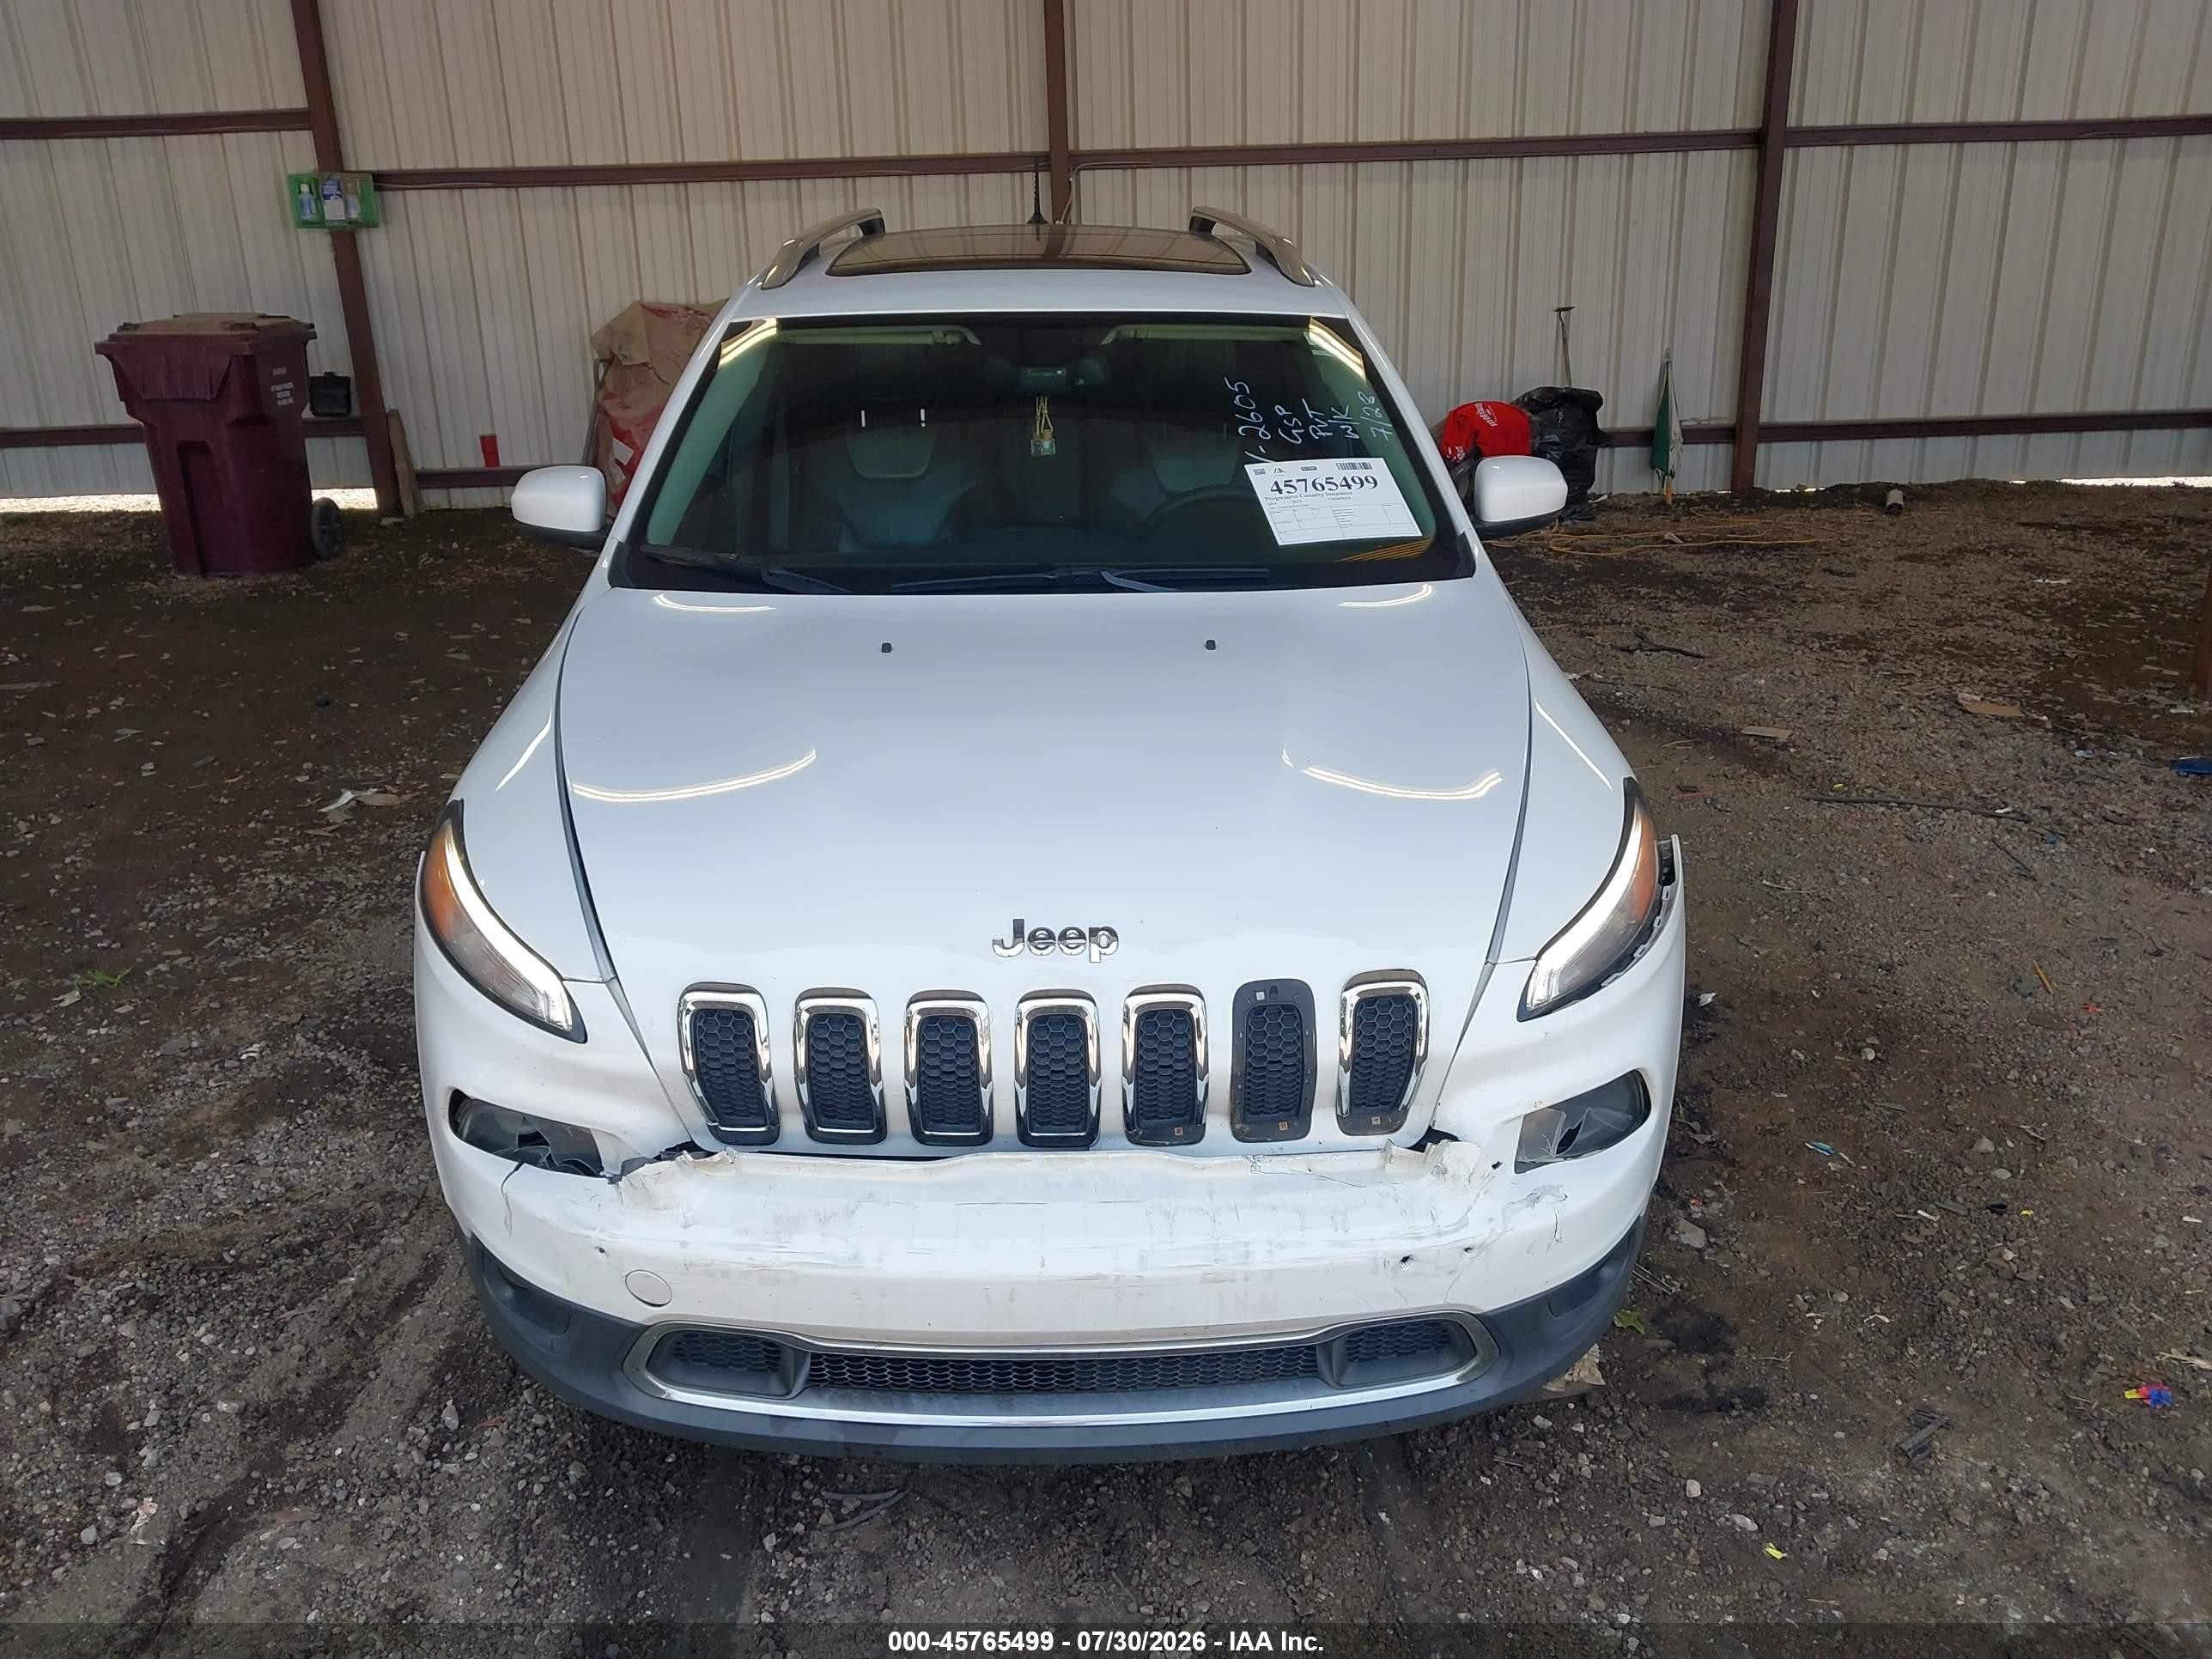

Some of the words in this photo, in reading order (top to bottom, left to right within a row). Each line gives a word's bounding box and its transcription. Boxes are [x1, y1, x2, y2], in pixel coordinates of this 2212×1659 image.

[1357, 391, 1393, 441] 7/28
[1270, 475, 1378, 495] 45765499
[992, 918, 1119, 963] Jeep
